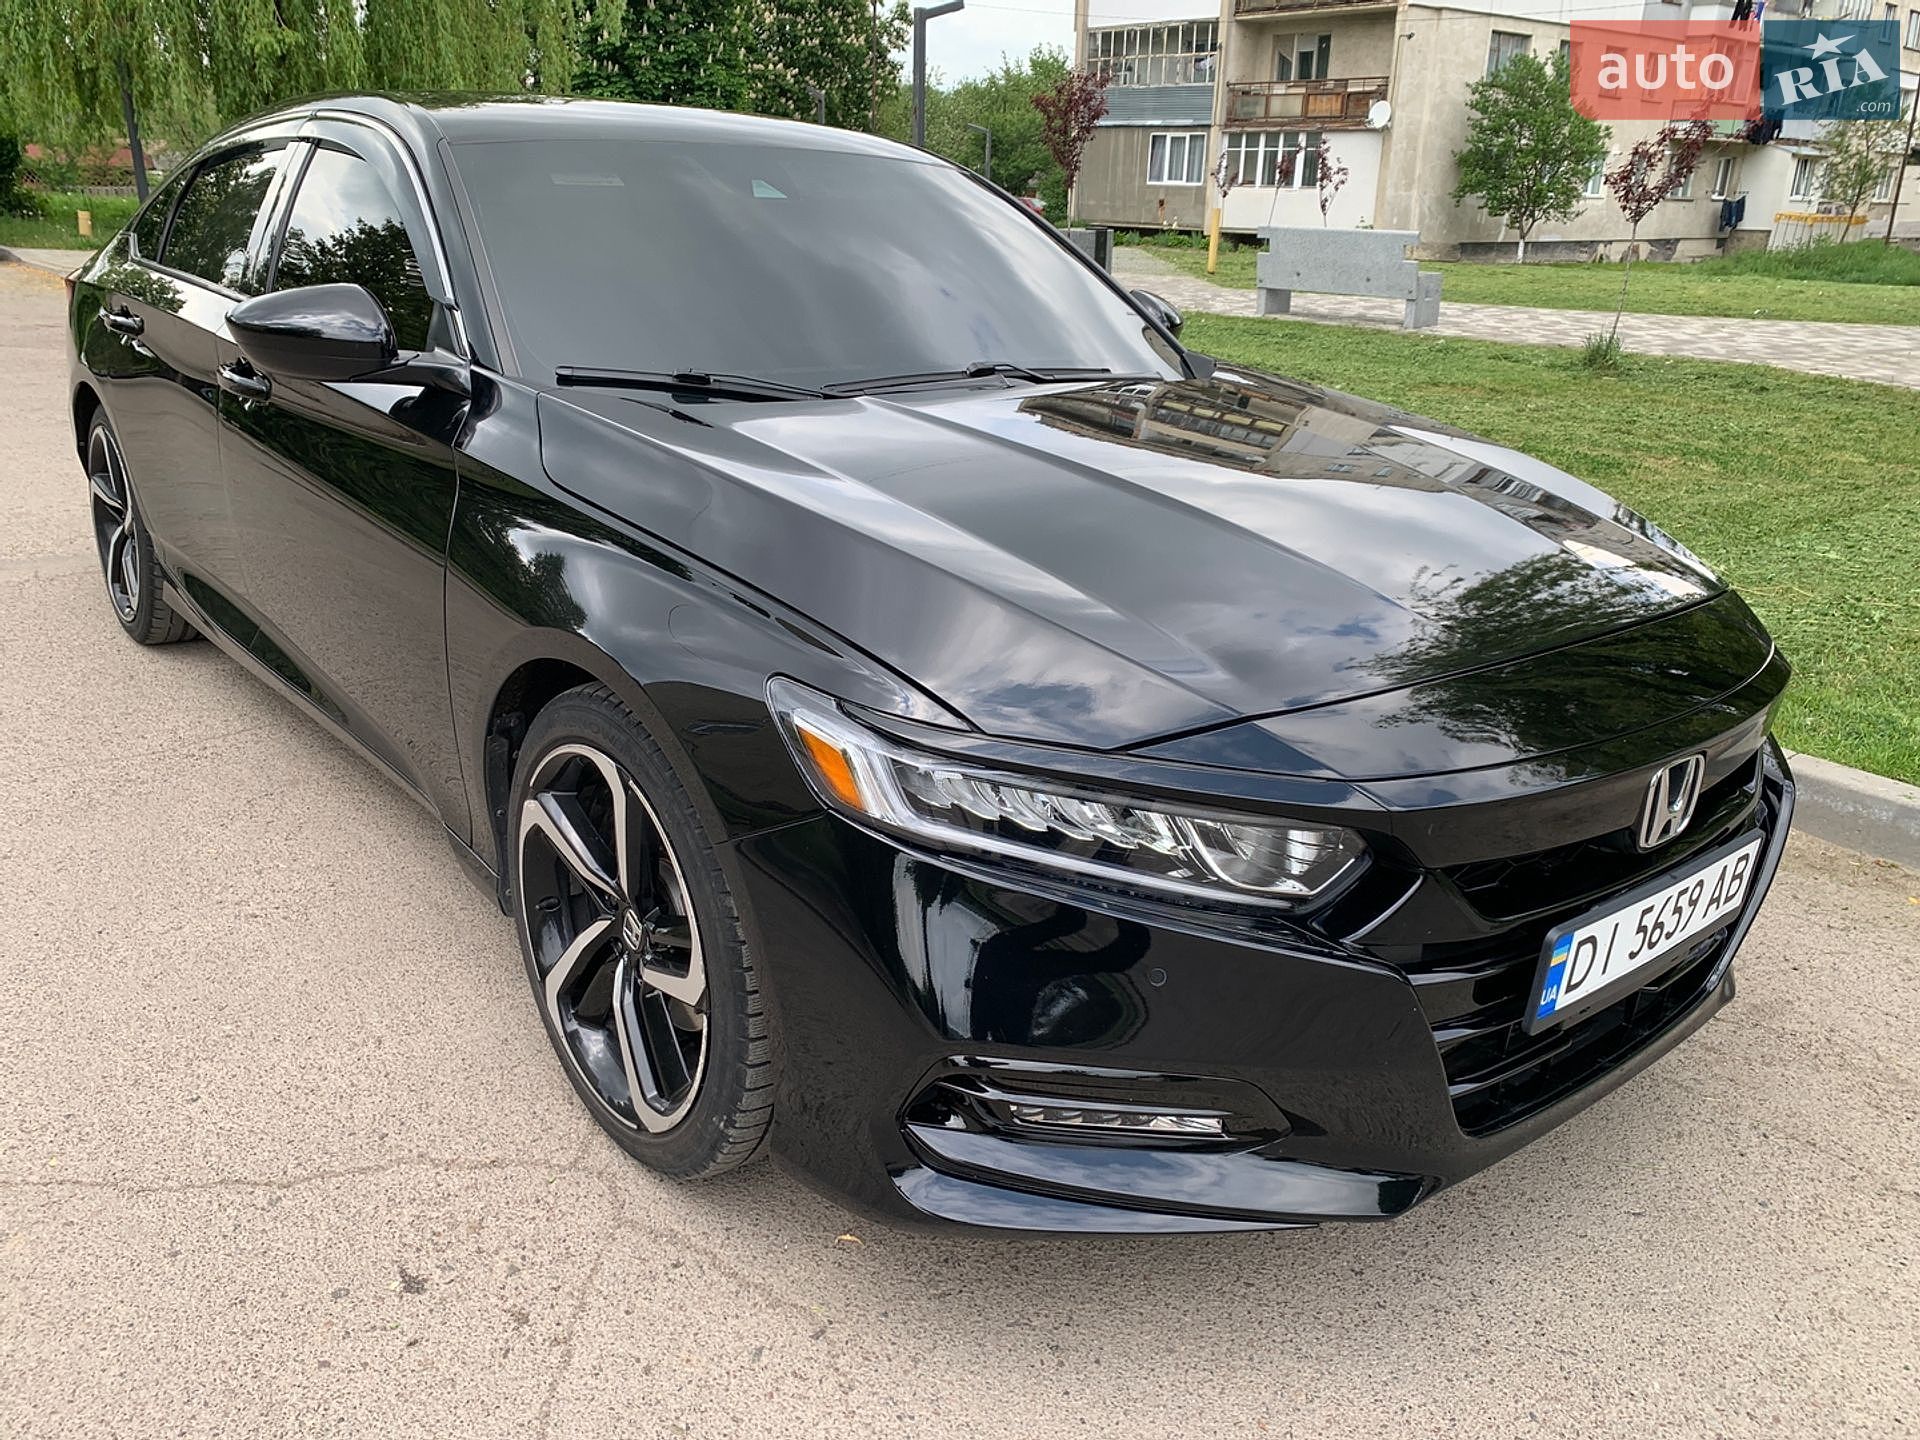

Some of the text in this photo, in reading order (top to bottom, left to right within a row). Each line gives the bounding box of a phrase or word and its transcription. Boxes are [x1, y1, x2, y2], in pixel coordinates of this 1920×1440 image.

[1564, 853, 1750, 995] DI 5659 AB
[1540, 986, 1557, 1005] UA
